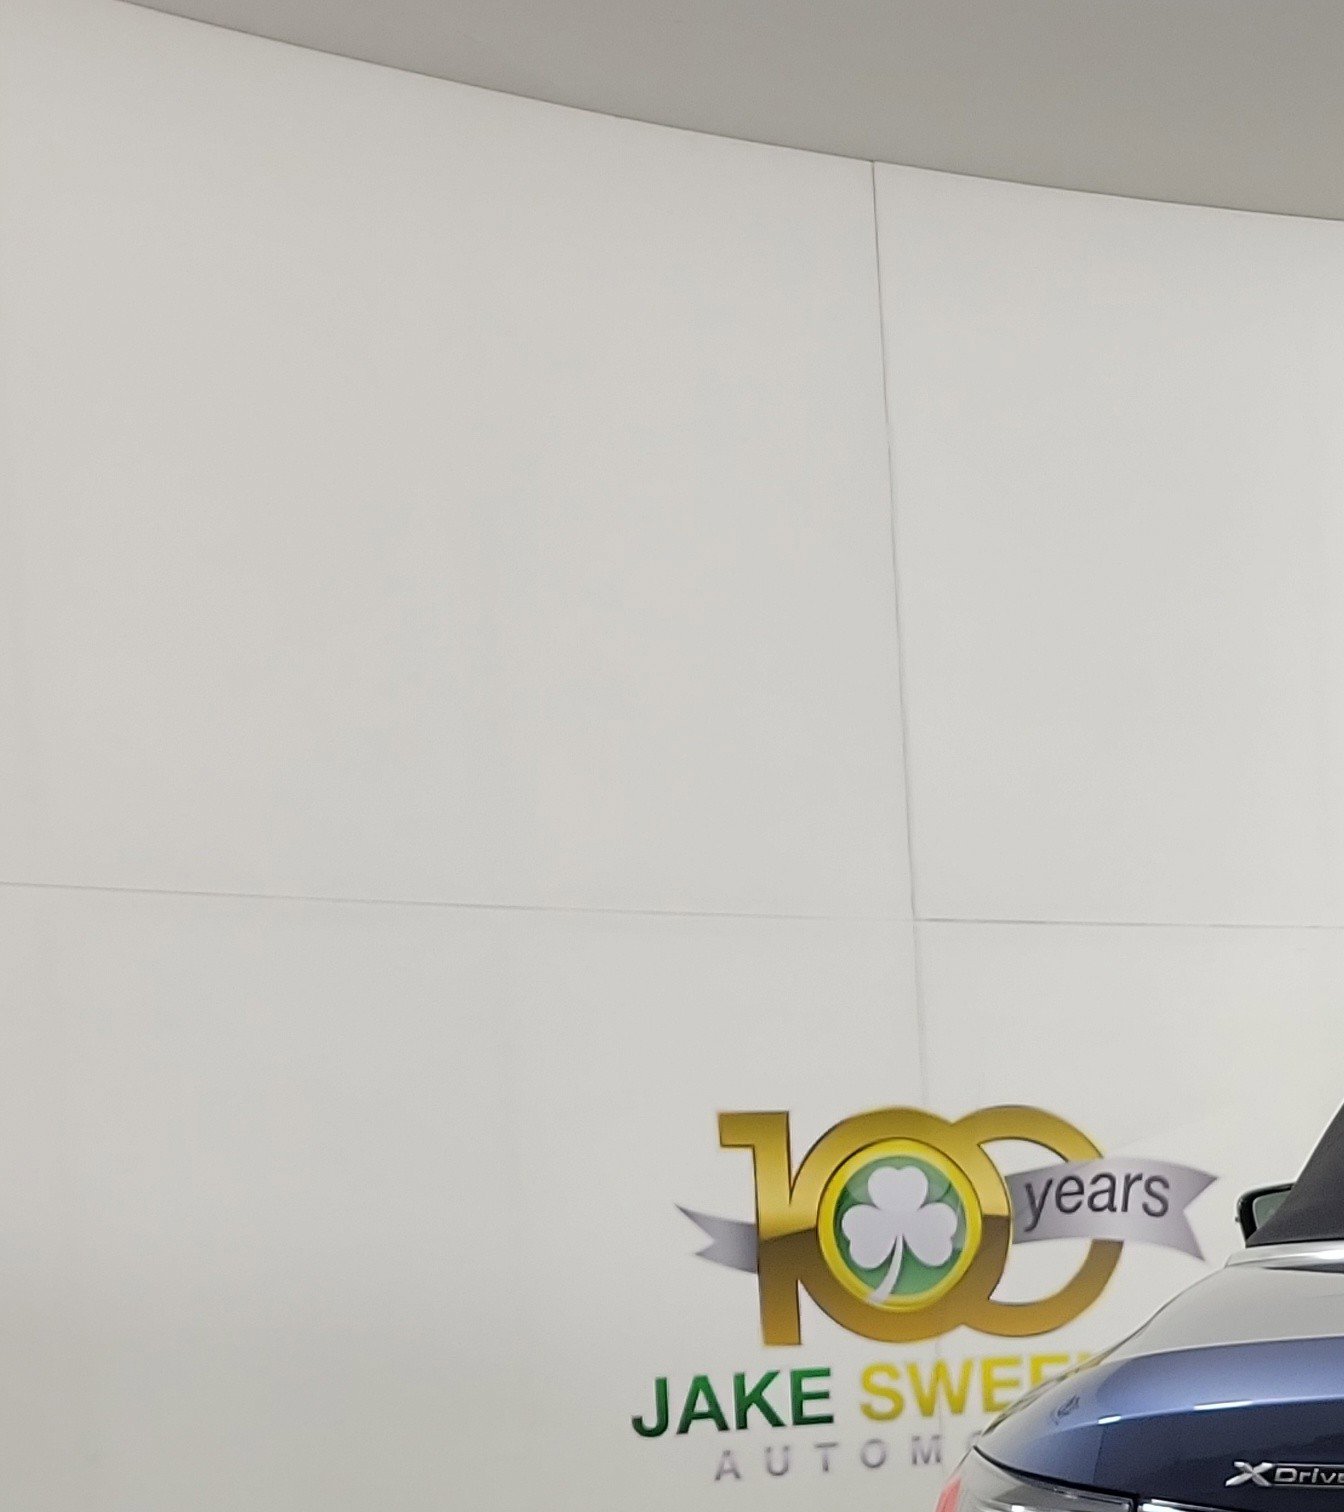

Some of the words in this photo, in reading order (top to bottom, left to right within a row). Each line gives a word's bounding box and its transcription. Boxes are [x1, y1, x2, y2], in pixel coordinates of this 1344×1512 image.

[1023, 1171, 1172, 1232] years
[631, 1367, 835, 1438] JAKE
[714, 1431, 983, 1483] AUTOM
